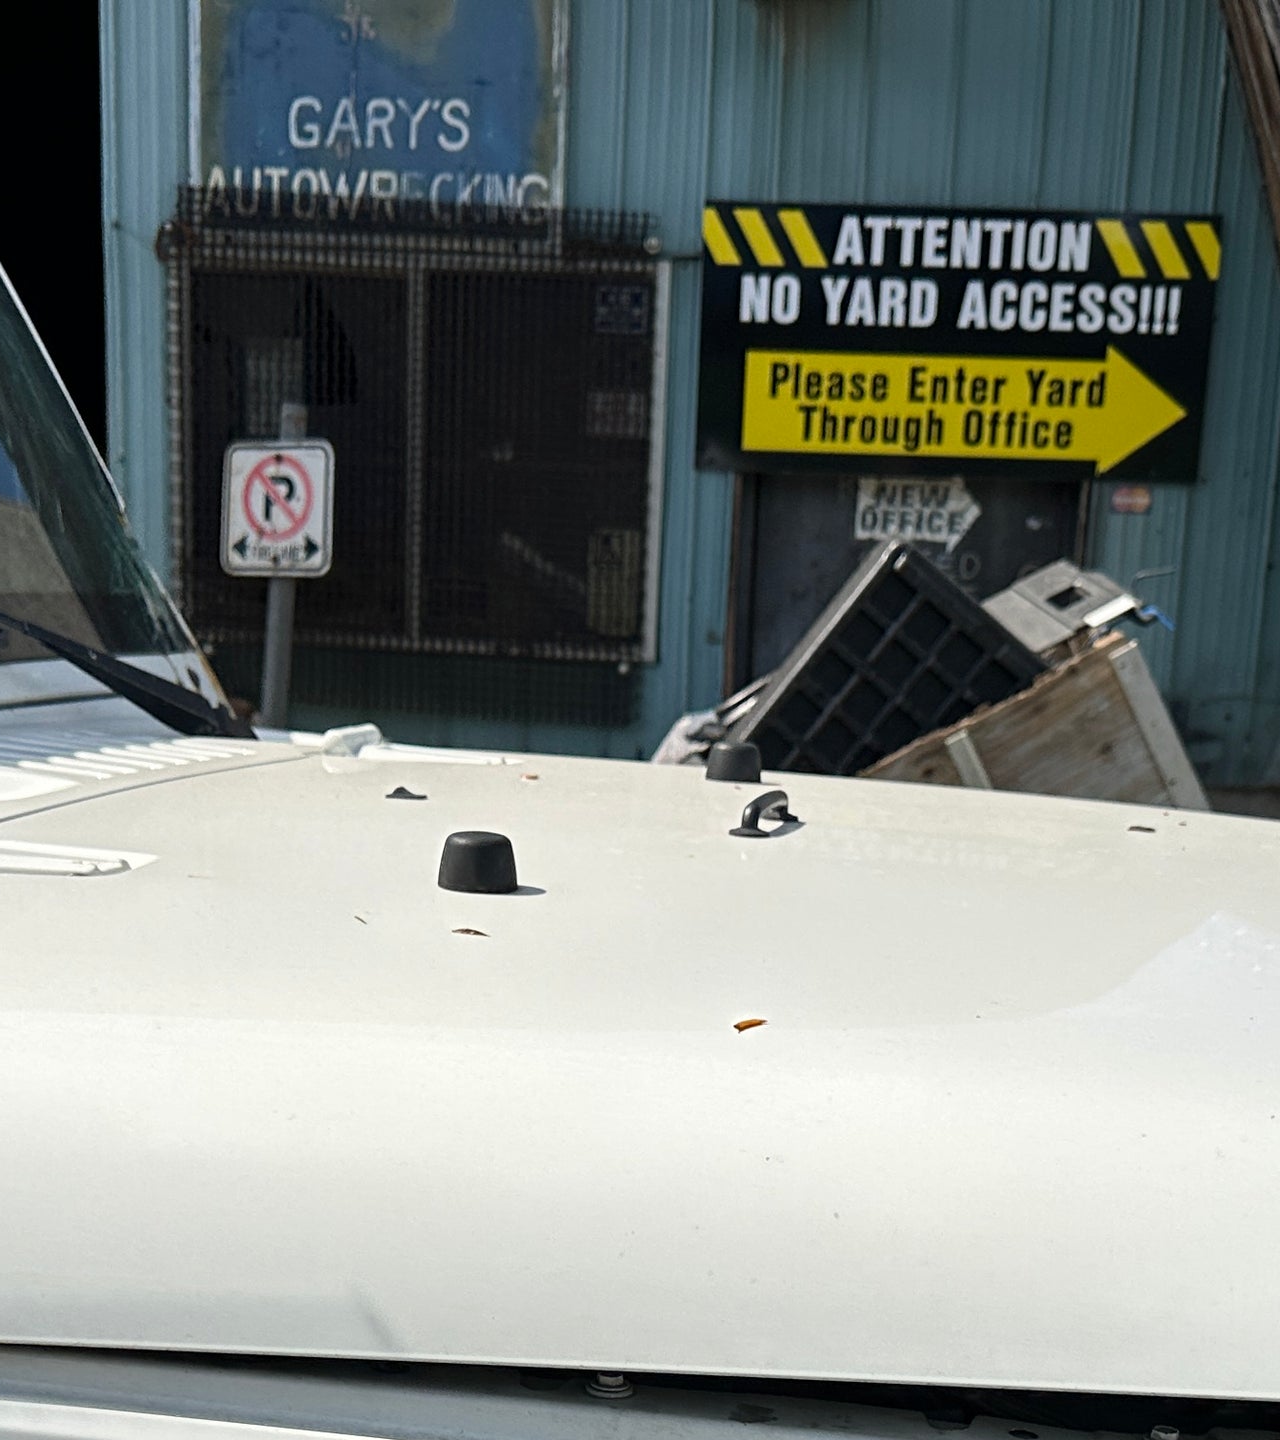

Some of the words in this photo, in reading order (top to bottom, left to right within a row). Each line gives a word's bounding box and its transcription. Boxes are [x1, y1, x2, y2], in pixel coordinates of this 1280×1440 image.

[288, 95, 472, 152] GARY'S
[832, 215, 1092, 272] ATTENTION
[738, 273, 801, 325] NO
[821, 276, 939, 329] YARD
[957, 280, 1182, 335] ACCESS!!!
[770, 362, 890, 402] Please
[907, 365, 1008, 405] Enter
[1026, 368, 1107, 409] Yard
[798, 406, 943, 452] Through
[963, 410, 1074, 450] Office
[860, 504, 967, 534] OFFICE
[875, 483, 951, 509] NEW
